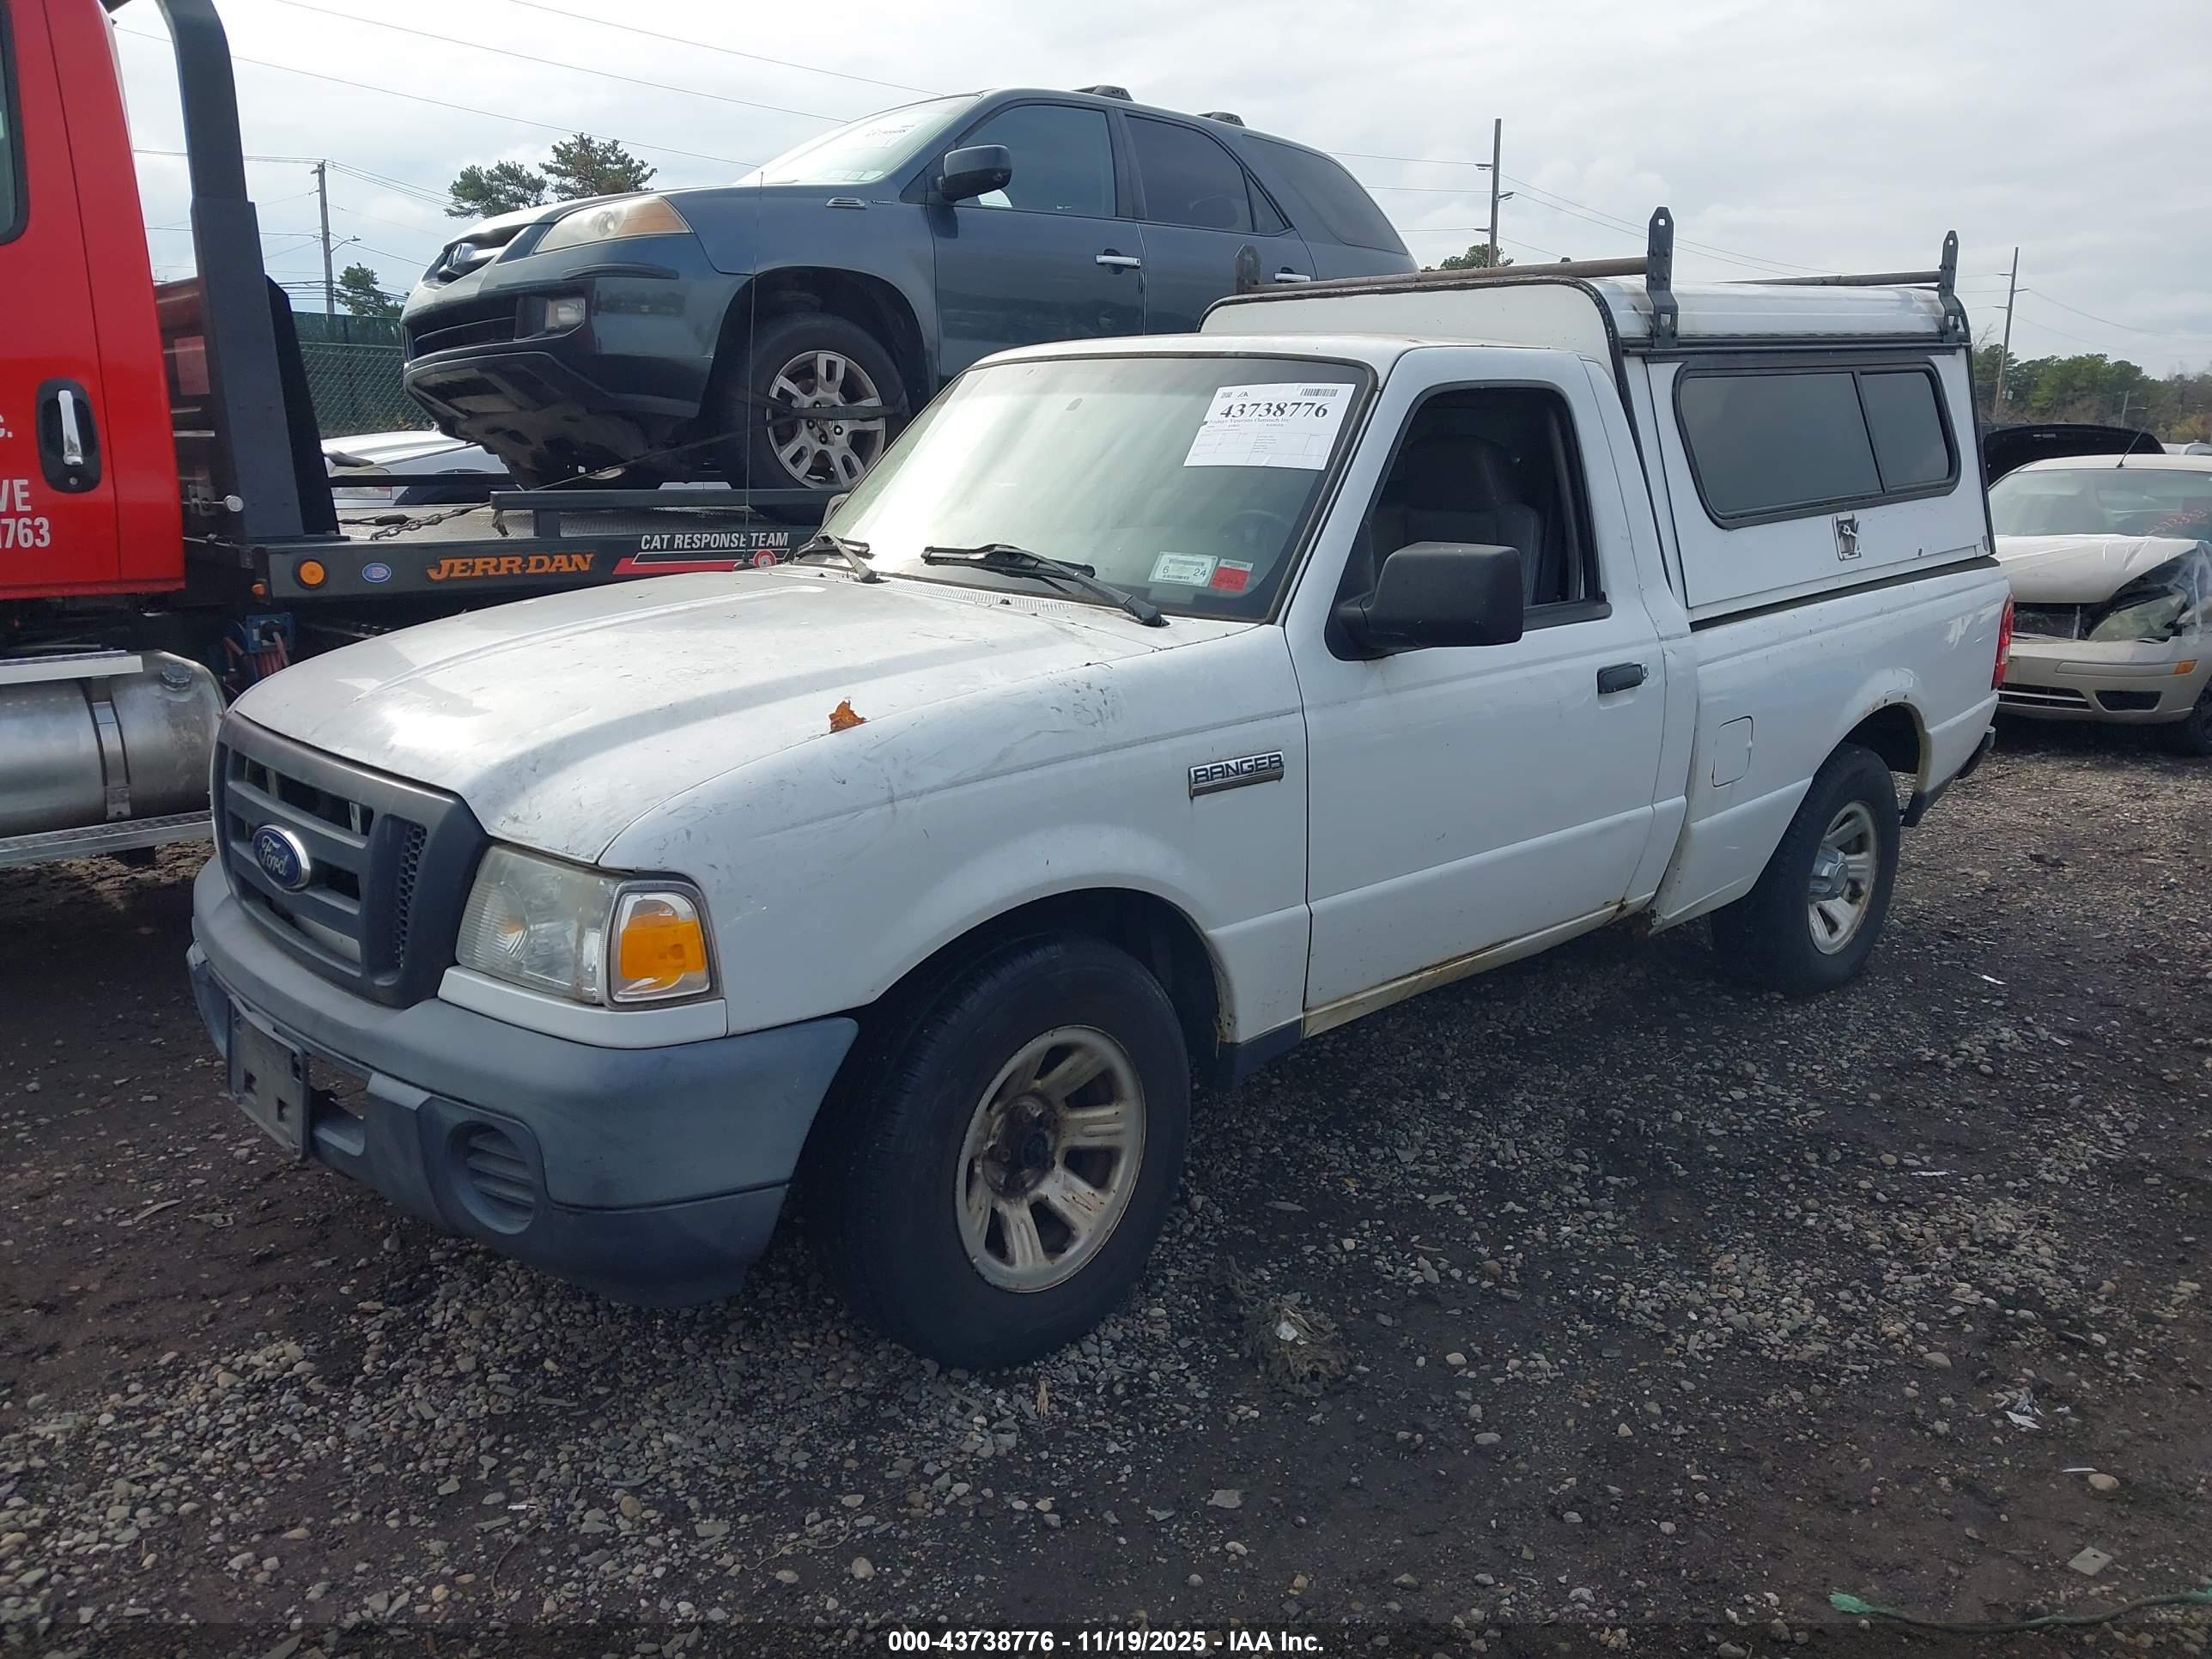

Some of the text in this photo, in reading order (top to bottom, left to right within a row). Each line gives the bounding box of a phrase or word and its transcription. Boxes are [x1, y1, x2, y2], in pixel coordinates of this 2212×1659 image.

[1220, 402, 1331, 418] 43738776
[0, 517, 51, 549] 763
[641, 532, 789, 550] CAT RESPONSE TEAM
[427, 554, 594, 580] JERR-DAN
[1163, 565, 1170, 574] 6
[1193, 568, 1206, 578] 24
[1193, 753, 1284, 784] RANGER
[259, 835, 289, 876] Ford
